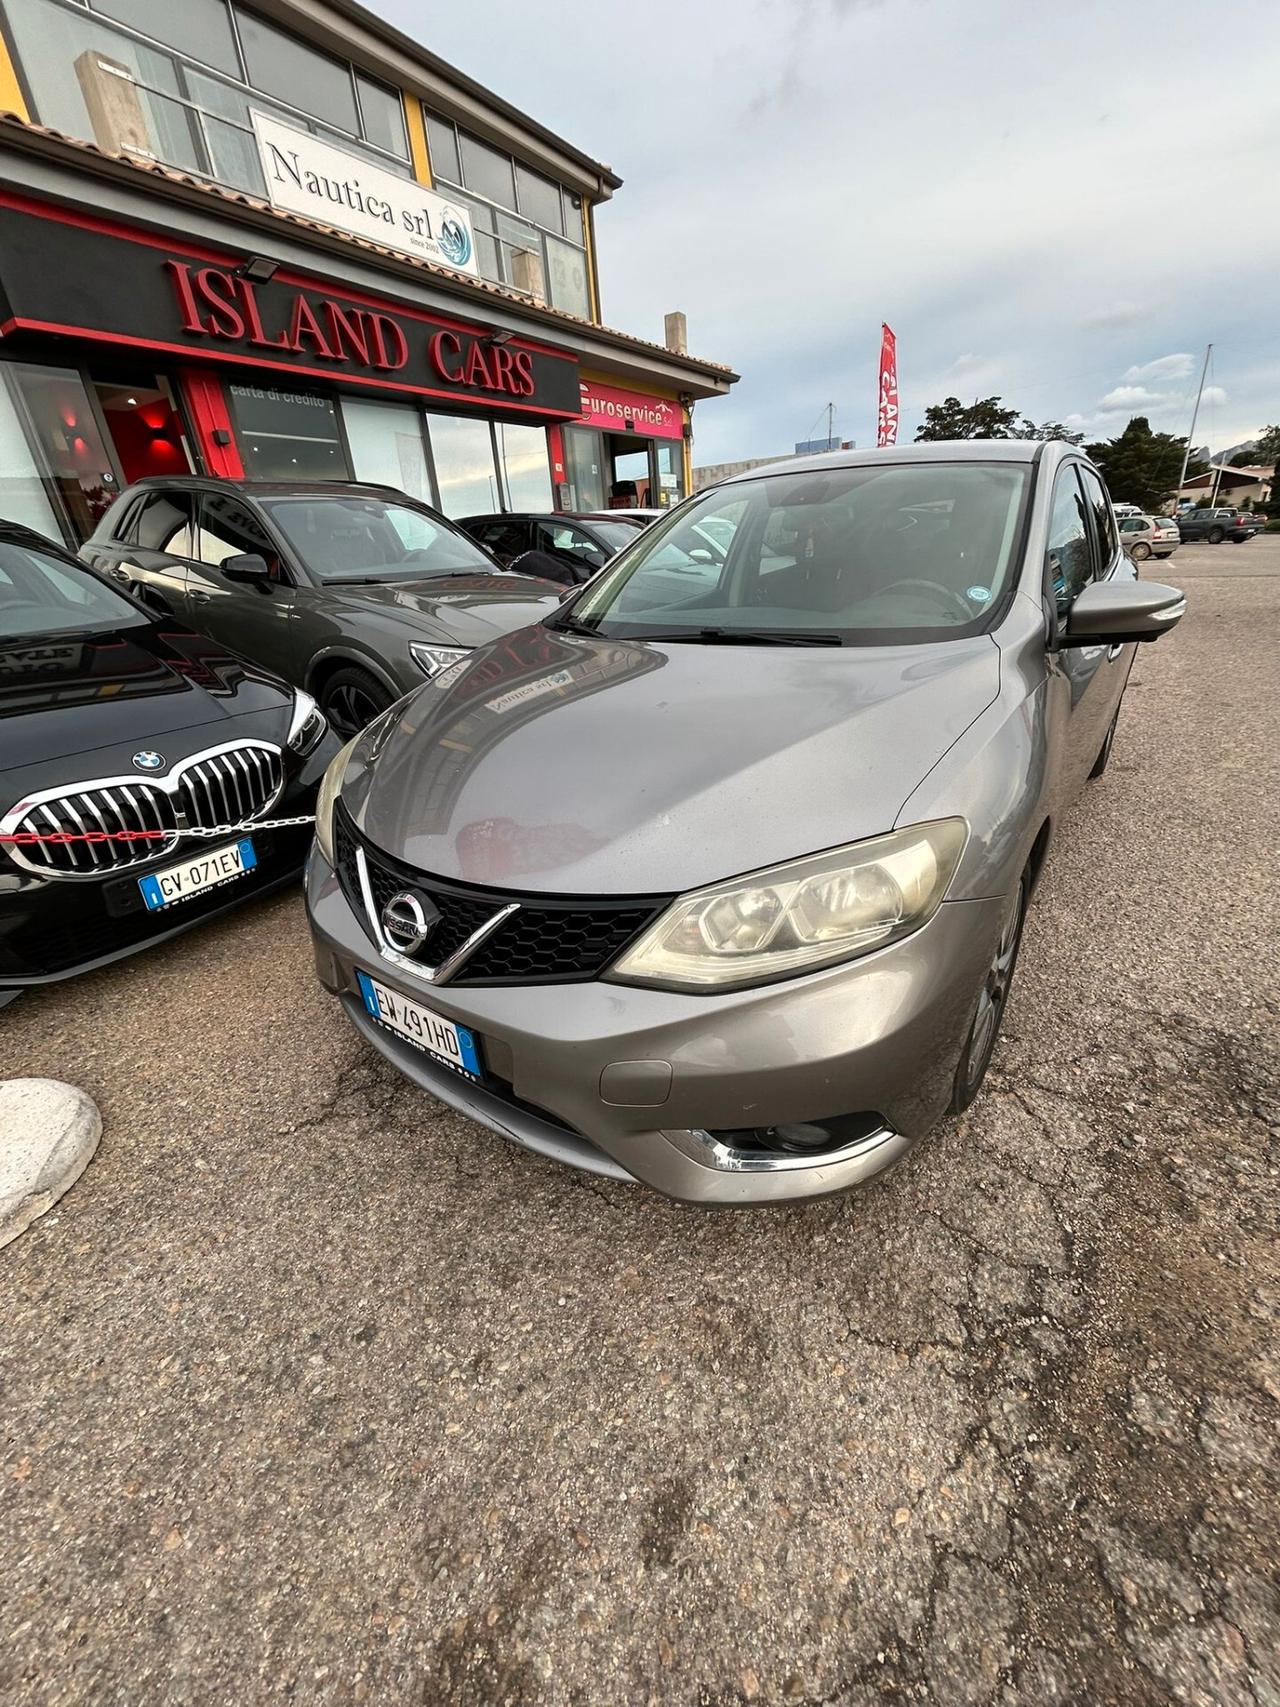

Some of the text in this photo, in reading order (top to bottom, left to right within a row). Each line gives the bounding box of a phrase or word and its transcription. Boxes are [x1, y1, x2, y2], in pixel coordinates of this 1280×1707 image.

[266, 141, 434, 240] Nautica srl
[163, 259, 535, 397] ISLAND CARS
[230, 385, 325, 407] carta di credito
[181, 875, 239, 902] ISLAND CARS
[393, 1029, 456, 1070] ISLAND CARS
